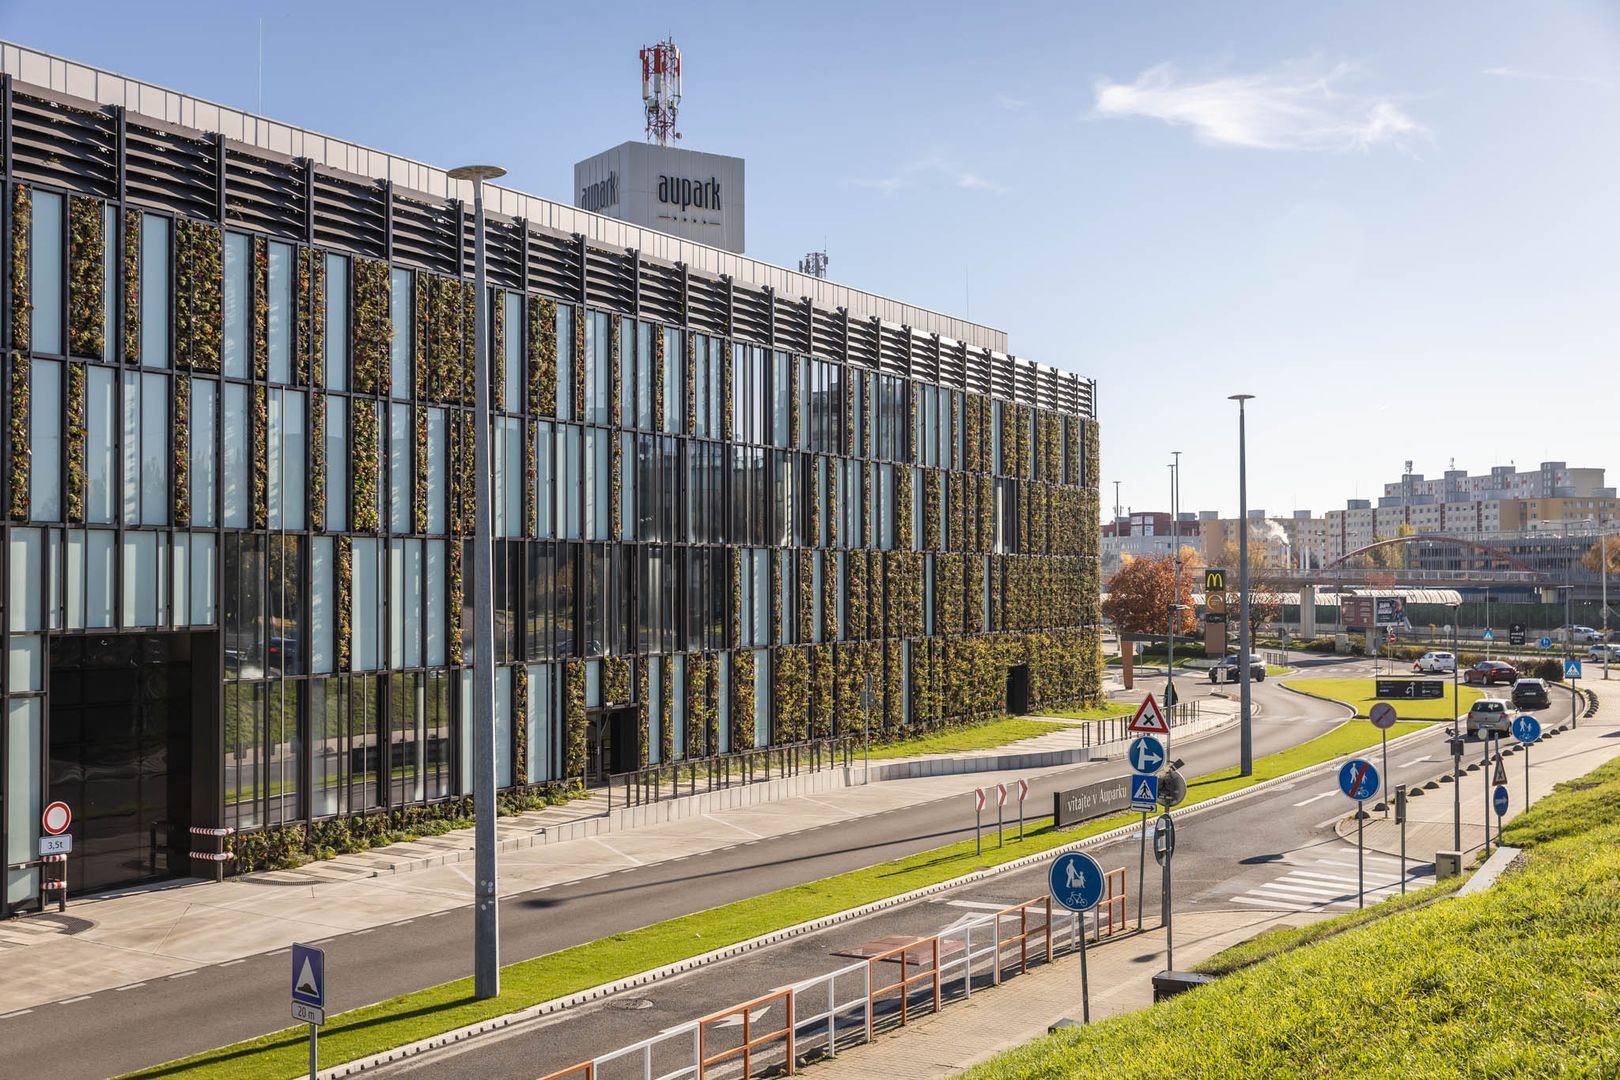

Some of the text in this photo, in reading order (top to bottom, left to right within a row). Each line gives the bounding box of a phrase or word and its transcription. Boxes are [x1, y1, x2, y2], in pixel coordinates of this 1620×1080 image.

[658, 175, 721, 211] aupark
[1207, 573, 1223, 588] M
[1067, 784, 1127, 813] vitajte v Auparku
[48, 841, 63, 850] 3,5t
[298, 1005, 315, 1021] 20 m
